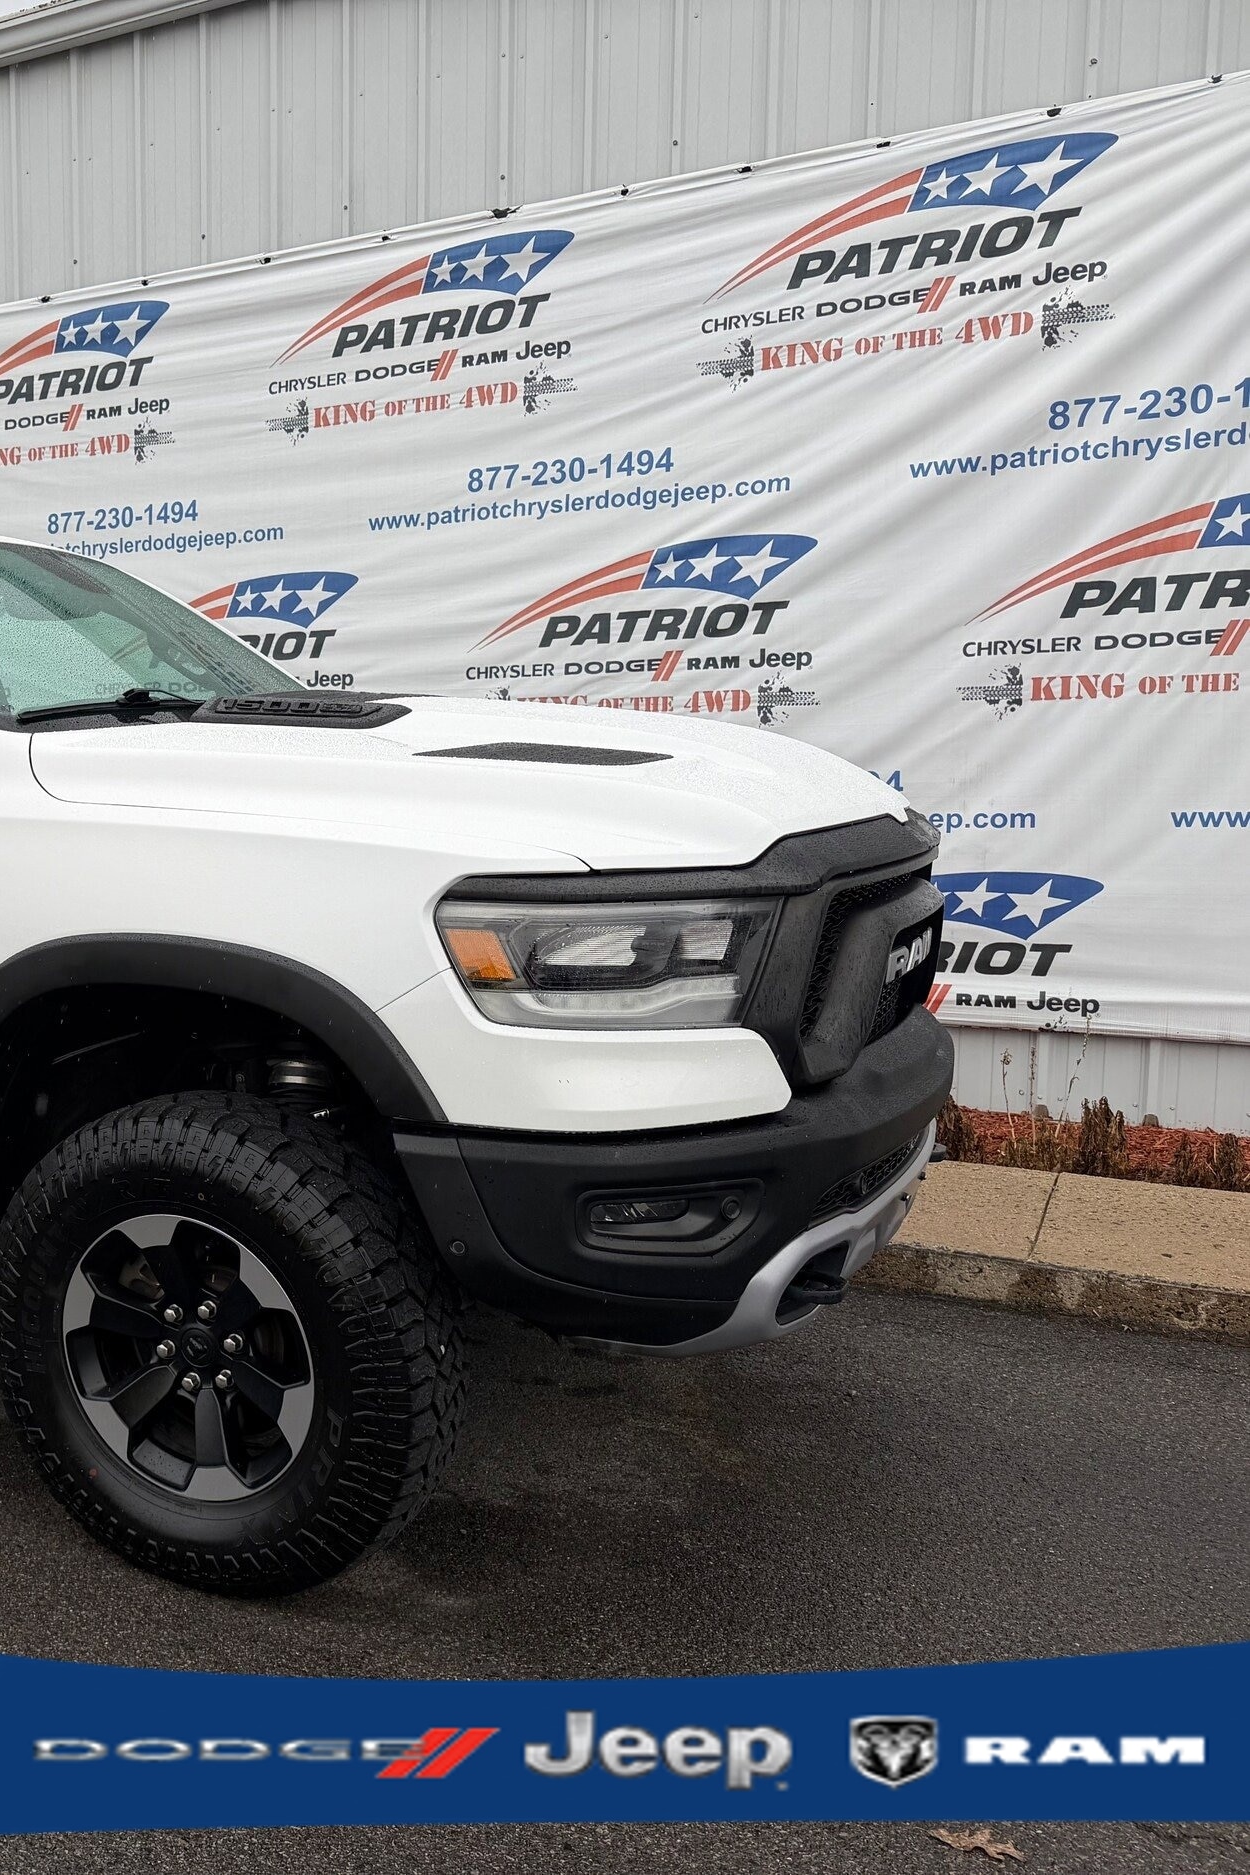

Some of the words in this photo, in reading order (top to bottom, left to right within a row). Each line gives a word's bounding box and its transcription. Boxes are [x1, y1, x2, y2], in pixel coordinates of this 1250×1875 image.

[786, 207, 1082, 290] PATRIOT
[701, 307, 805, 334] CHRYSLER
[816, 288, 931, 317] DODGE
[959, 275, 1022, 296] RAM
[1032, 260, 1108, 286] Jeep
[331, 293, 551, 358] PATRIOT
[761, 338, 844, 371] KING
[855, 336, 884, 355] OF
[889, 328, 943, 350] THE
[956, 311, 1034, 345] 4WD
[268, 372, 347, 395] CHRYSLER
[355, 359, 439, 382] DODGE
[461, 350, 508, 368] RAM
[516, 340, 571, 360] Jeep
[4, 412, 69, 431] DODGE
[86, 406, 122, 420] RAM
[127, 398, 169, 418] Jeep
[314, 401, 376, 429] KING
[384, 400, 407, 416] OF
[411, 393, 450, 413] THE
[459, 382, 519, 409] 4WD
[1049, 377, 1250, 430] 877-230-1
[27, 446, 46, 462] OF
[48, 443, 79, 460] THE
[85, 434, 130, 457] 4WD
[467, 447, 674, 493] 877-230-1494
[910, 422, 1250, 478] www.patriotchryslerd
[48, 500, 198, 534] 877-230-1494
[368, 475, 791, 532] www.patriotchryslerdodgejeep.com
[538, 601, 789, 648] PATRIOT
[962, 636, 1081, 657] CHRYSLER
[1095, 629, 1226, 650] DODGE
[307, 671, 353, 689] Jeep
[466, 664, 554, 680] CHRYSLER
[564, 659, 662, 675] DODGE
[687, 656, 740, 670] RAM
[749, 647, 813, 670] Jeep
[631, 696, 673, 712] THE
[684, 690, 750, 713] 4WD
[1030, 673, 1125, 701] KING
[1138, 676, 1173, 694] OF
[1182, 673, 1239, 692] THE
[956, 993, 1016, 1009] RAM
[1027, 991, 1100, 1017] Jeep
